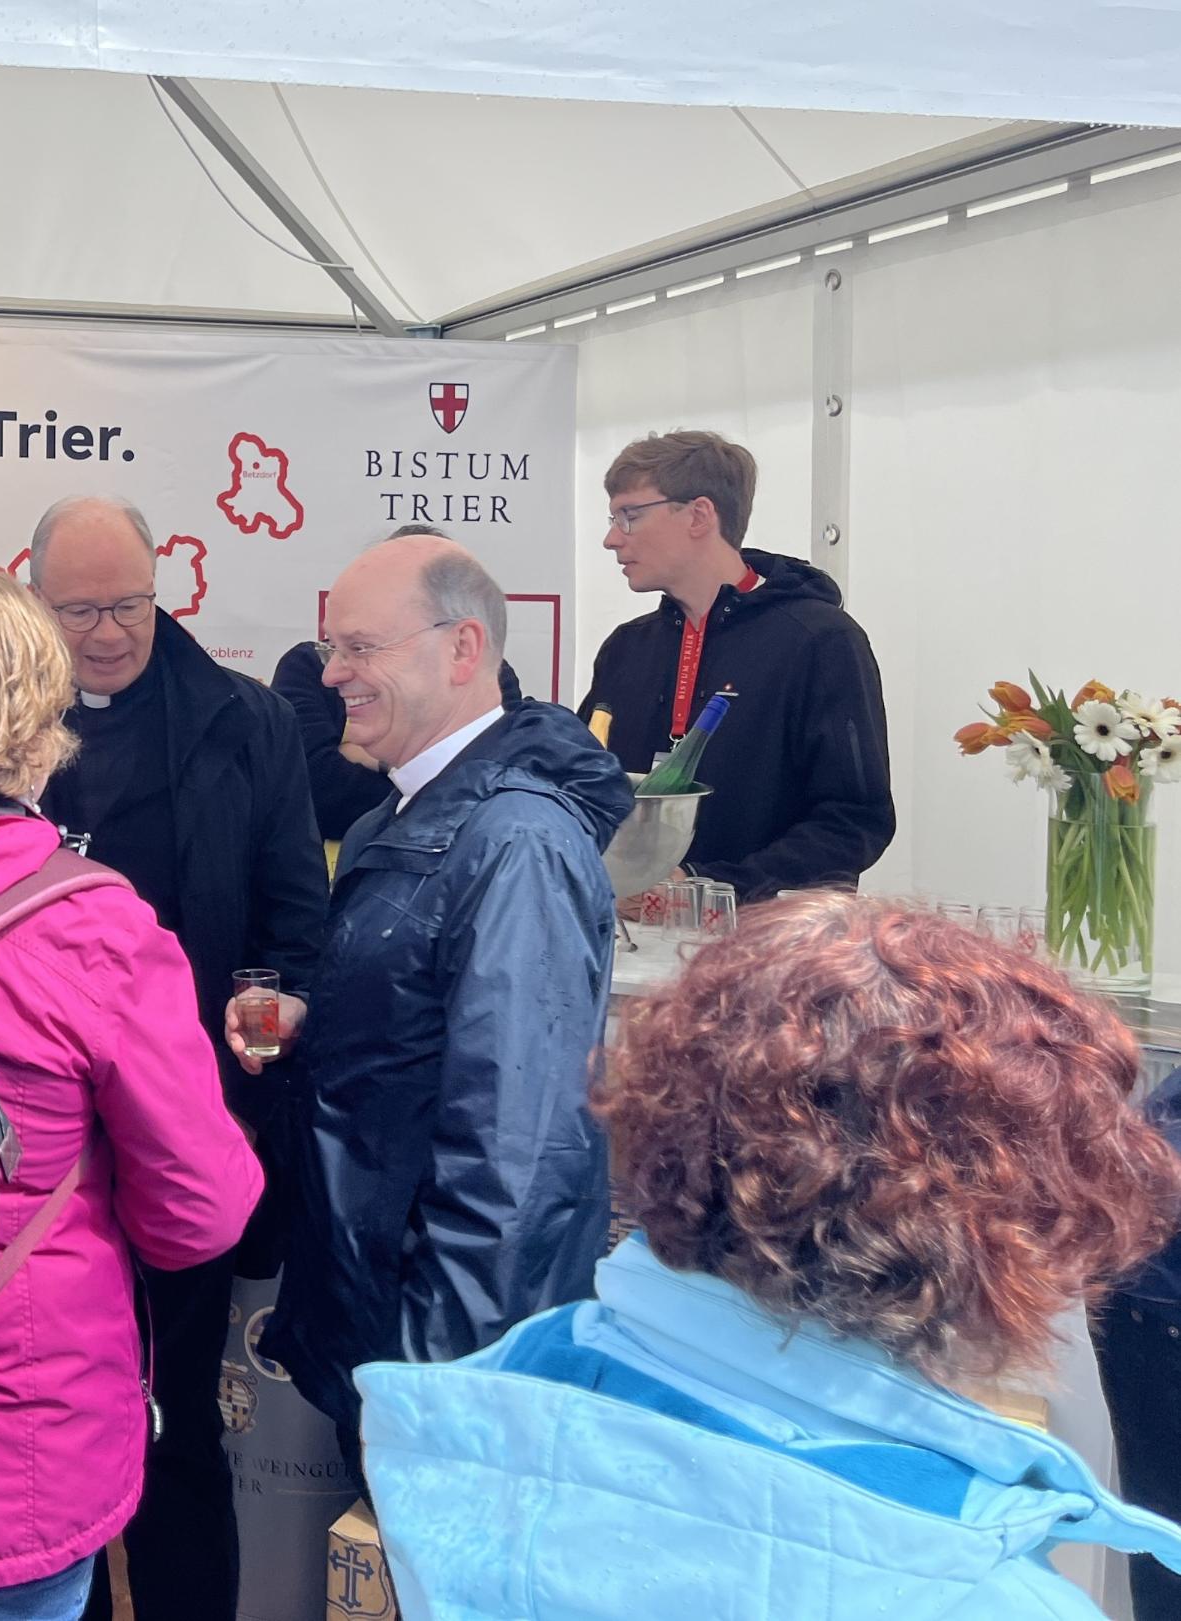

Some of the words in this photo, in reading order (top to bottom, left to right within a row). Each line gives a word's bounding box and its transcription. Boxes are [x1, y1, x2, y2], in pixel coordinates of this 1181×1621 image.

[242, 470, 277, 478] Betzdorf
[365, 450, 530, 480] BISTUM
[380, 493, 512, 523] TRIER
